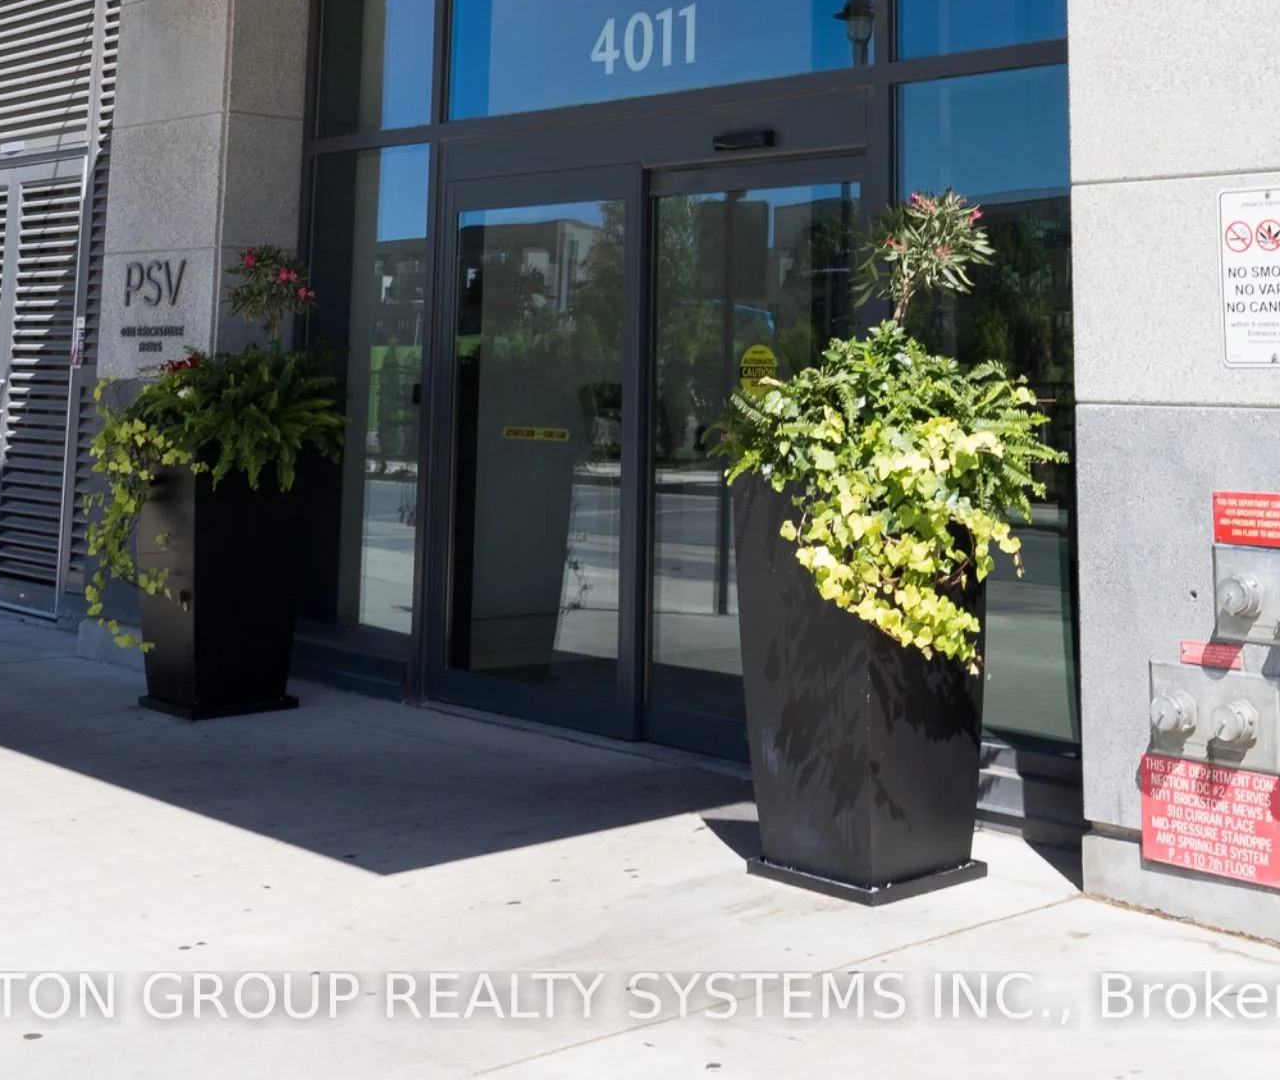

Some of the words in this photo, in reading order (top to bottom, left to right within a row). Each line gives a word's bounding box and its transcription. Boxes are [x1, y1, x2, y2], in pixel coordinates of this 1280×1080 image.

[590, 3, 696, 75] 4011
[124, 259, 186, 307] PSV
[1228, 268, 1247, 278] NO
[1235, 285, 1254, 295] NO
[1227, 302, 1246, 313] NO
[1146, 758, 1164, 772] THIS
[1168, 762, 1185, 776] FIRE
[1189, 766, 1250, 787] DEPARTMENT
[1253, 777, 1276, 791] CON-
[1152, 773, 1189, 790] NECTION
[1195, 780, 1209, 794] FDC
[1213, 784, 1225, 797] #2
[1235, 790, 1271, 807] SERVES
[1151, 787, 1170, 801] 4011
[1174, 791, 1230, 813] BRICKSTONE
[1233, 804, 1263, 821] MEWS
[1266, 811, 1272, 822] &
[1167, 804, 1182, 818] 510
[1185, 808, 1223, 827] CURRAN
[1226, 818, 1255, 834] PLACE
[1152, 816, 1218, 841] MID-PRESSURE
[1222, 829, 1272, 852] STANDPIPE
[1156, 831, 1175, 846] AND
[1178, 835, 1227, 857] SPRINKLER
[1230, 846, 1269, 866] SYSTEM
[1169, 846, 1175, 860] P
[1194, 854, 1205, 867] TO
[1225, 861, 1256, 878] FLOOR
